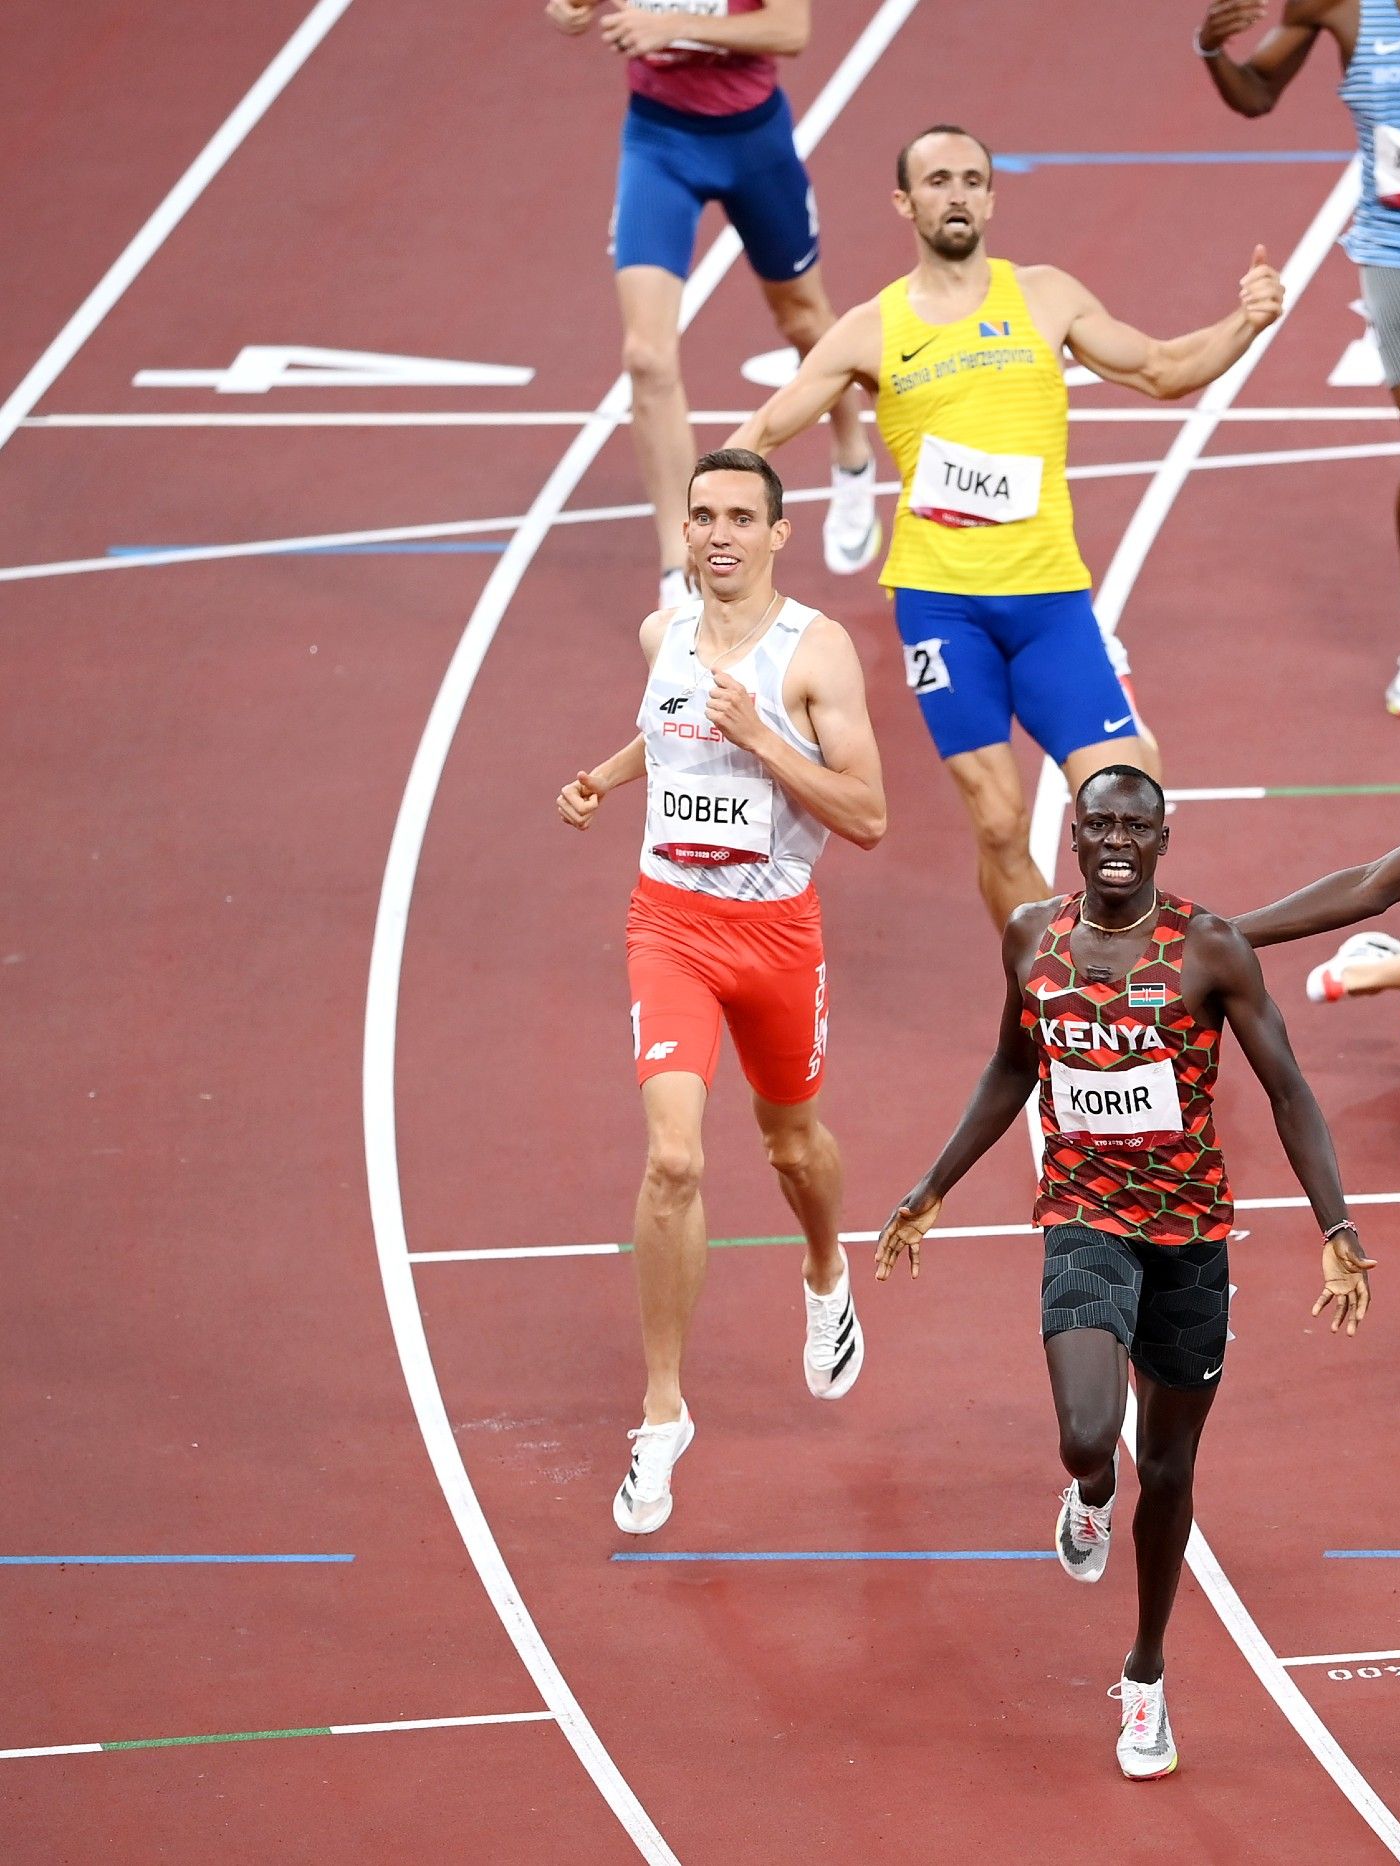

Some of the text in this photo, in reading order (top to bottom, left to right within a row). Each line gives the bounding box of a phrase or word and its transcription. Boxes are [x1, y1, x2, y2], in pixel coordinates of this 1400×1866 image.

[891, 348, 1035, 395] Bosnia and Herzegovina
[943, 460, 1010, 500] TUKA
[913, 649, 937, 688] 2
[659, 697, 689, 714] 4F
[663, 790, 750, 825] DOBEK
[805, 960, 828, 1082] POLSKA
[1039, 1017, 1167, 1051] KENYA
[1069, 1085, 1153, 1116] KORIR
